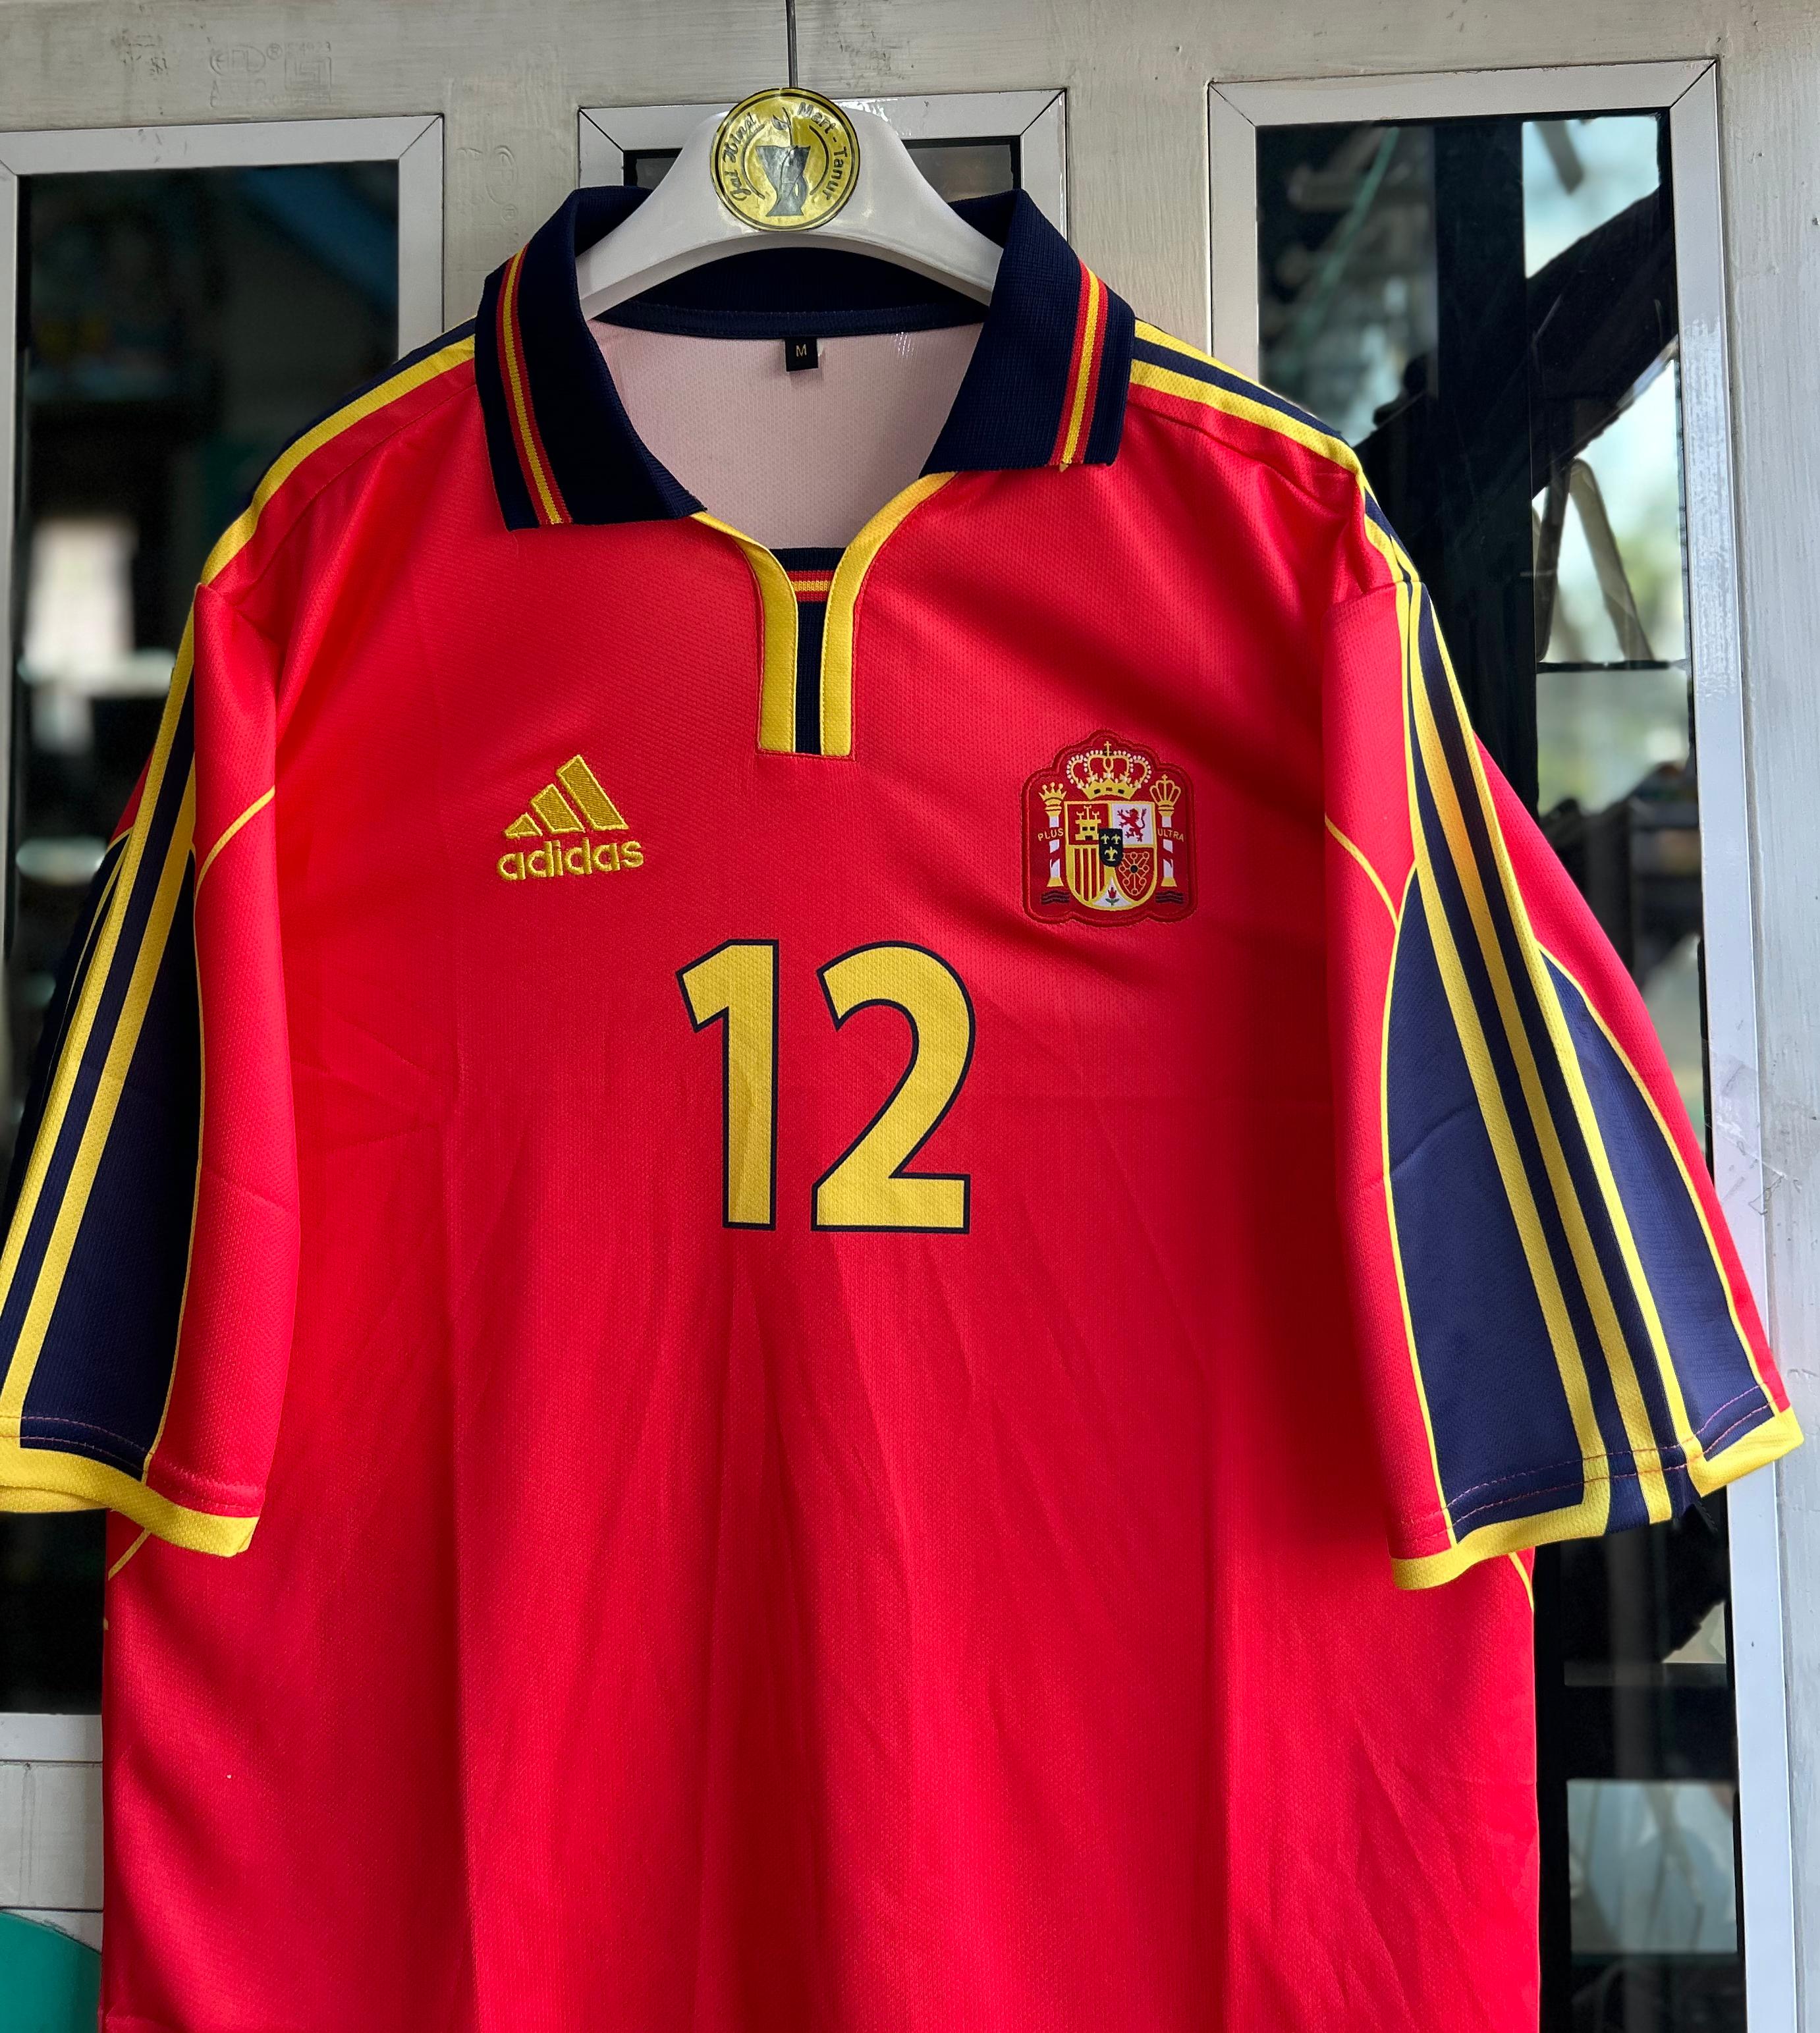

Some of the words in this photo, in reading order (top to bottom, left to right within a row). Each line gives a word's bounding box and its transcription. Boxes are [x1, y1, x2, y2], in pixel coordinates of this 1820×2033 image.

[796, 101, 837, 134] Mart
[821, 146, 848, 200] Tanur
[796, 344, 807, 358] M
[1037, 828, 1064, 842] PLUS
[1157, 828, 1185, 842] ULTRA
[497, 837, 644, 881] adidas
[675, 938, 976, 1235] 12
